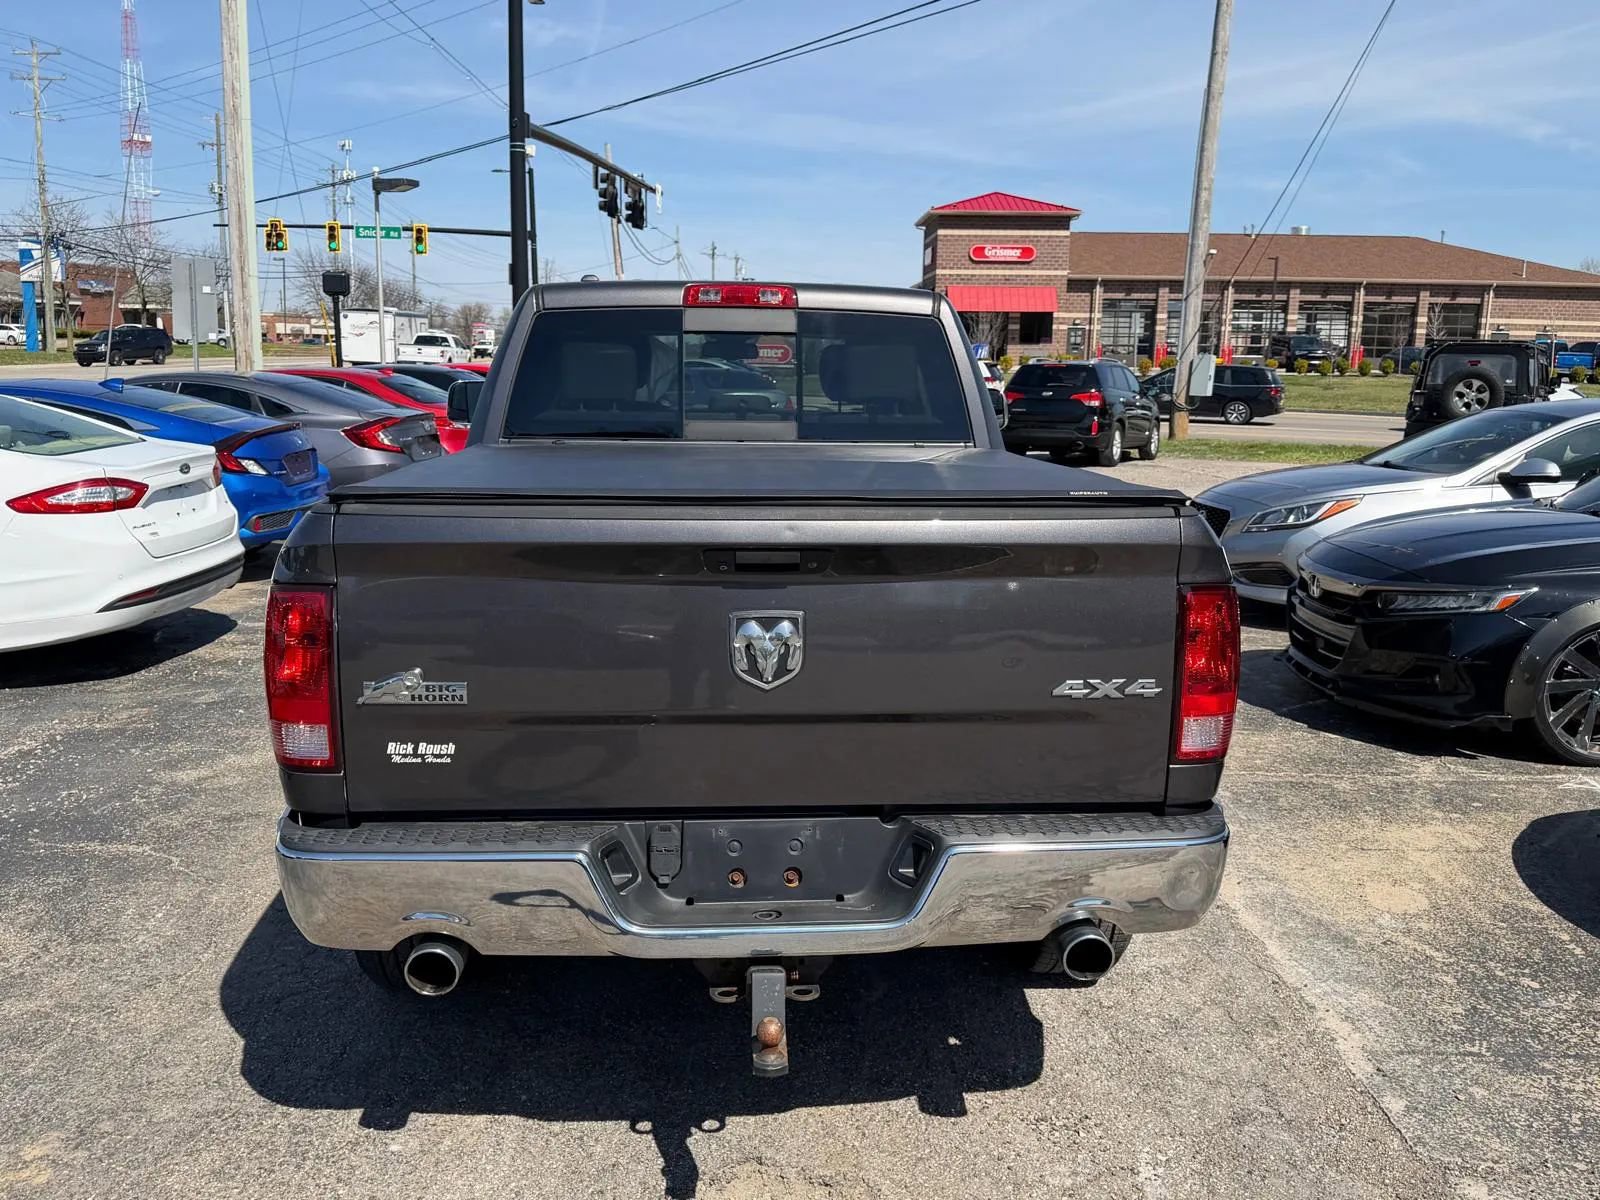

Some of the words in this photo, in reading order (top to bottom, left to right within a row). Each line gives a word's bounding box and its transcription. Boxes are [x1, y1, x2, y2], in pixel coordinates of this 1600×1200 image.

[984, 245, 1022, 257] Grismer
[424, 685, 457, 693] BIG
[1051, 679, 1162, 699] 4X4
[411, 694, 464, 702] HORN
[386, 741, 415, 755] Rick
[417, 741, 456, 755] Roush
[391, 755, 422, 764] Medina
[424, 755, 452, 763] Honda
